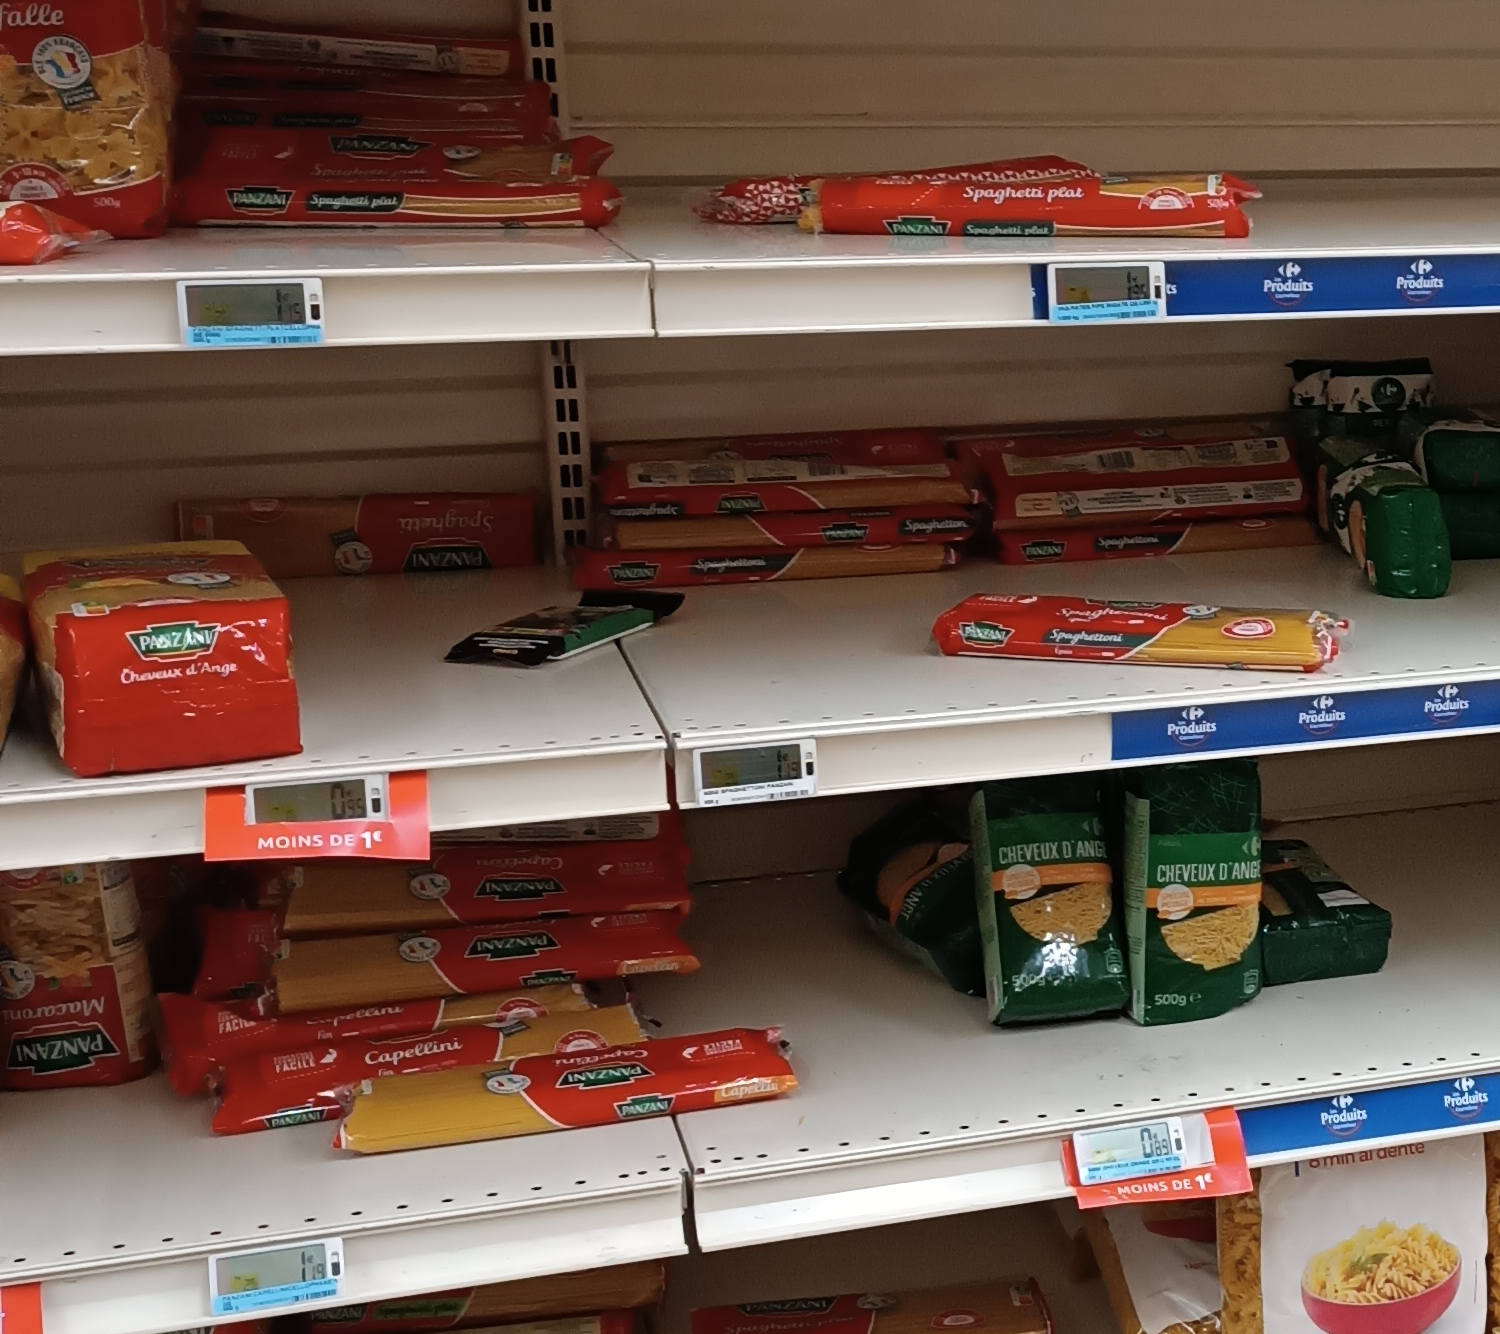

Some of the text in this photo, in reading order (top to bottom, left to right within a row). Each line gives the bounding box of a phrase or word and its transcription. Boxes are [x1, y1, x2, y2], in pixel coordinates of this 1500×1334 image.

[231, 189, 287, 210] PANZANI
[309, 190, 400, 211] Spaghetti plat
[962, 183, 1085, 207] Spaghetti plat
[893, 221, 943, 235] PANZANI
[966, 224, 1050, 238] Spaghetti plat
[1264, 277, 1314, 295] Produits
[397, 511, 494, 534] Spaghetti
[1098, 533, 1160, 549] Spaghettoni
[410, 550, 484, 569] PANZANI
[1026, 544, 1064, 558] PANZANI
[613, 566, 655, 580] PANZANI
[697, 556, 766, 572] Spaghettoni
[139, 630, 213, 652] PANZANI
[964, 624, 1010, 643] PANZANI
[1050, 627, 1125, 644] Spaghettoni
[120, 660, 237, 684] Cheveux d'Ange
[1299, 707, 1346, 724] Produits
[1167, 719, 1217, 736] Produits
[257, 832, 355, 849] MOINS DE
[999, 843, 1059, 865] CHEVEUX
[1156, 861, 1216, 883] CHEVEUX
[484, 879, 555, 895] PANZANI
[475, 934, 550, 954] PANZANI
[1154, 992, 1187, 1008] 500g
[2, 995, 105, 1026] Macaroni
[15, 1032, 104, 1062] PANZANI
[364, 1039, 462, 1065] Capellini
[567, 1065, 642, 1084] PANZANI
[620, 1098, 670, 1116] PANZANI
[1444, 1090, 1488, 1109] Produits
[270, 1110, 320, 1127] PANZANI
[1321, 1108, 1368, 1126] Produits
[1117, 1178, 1191, 1196] MOINS DE
